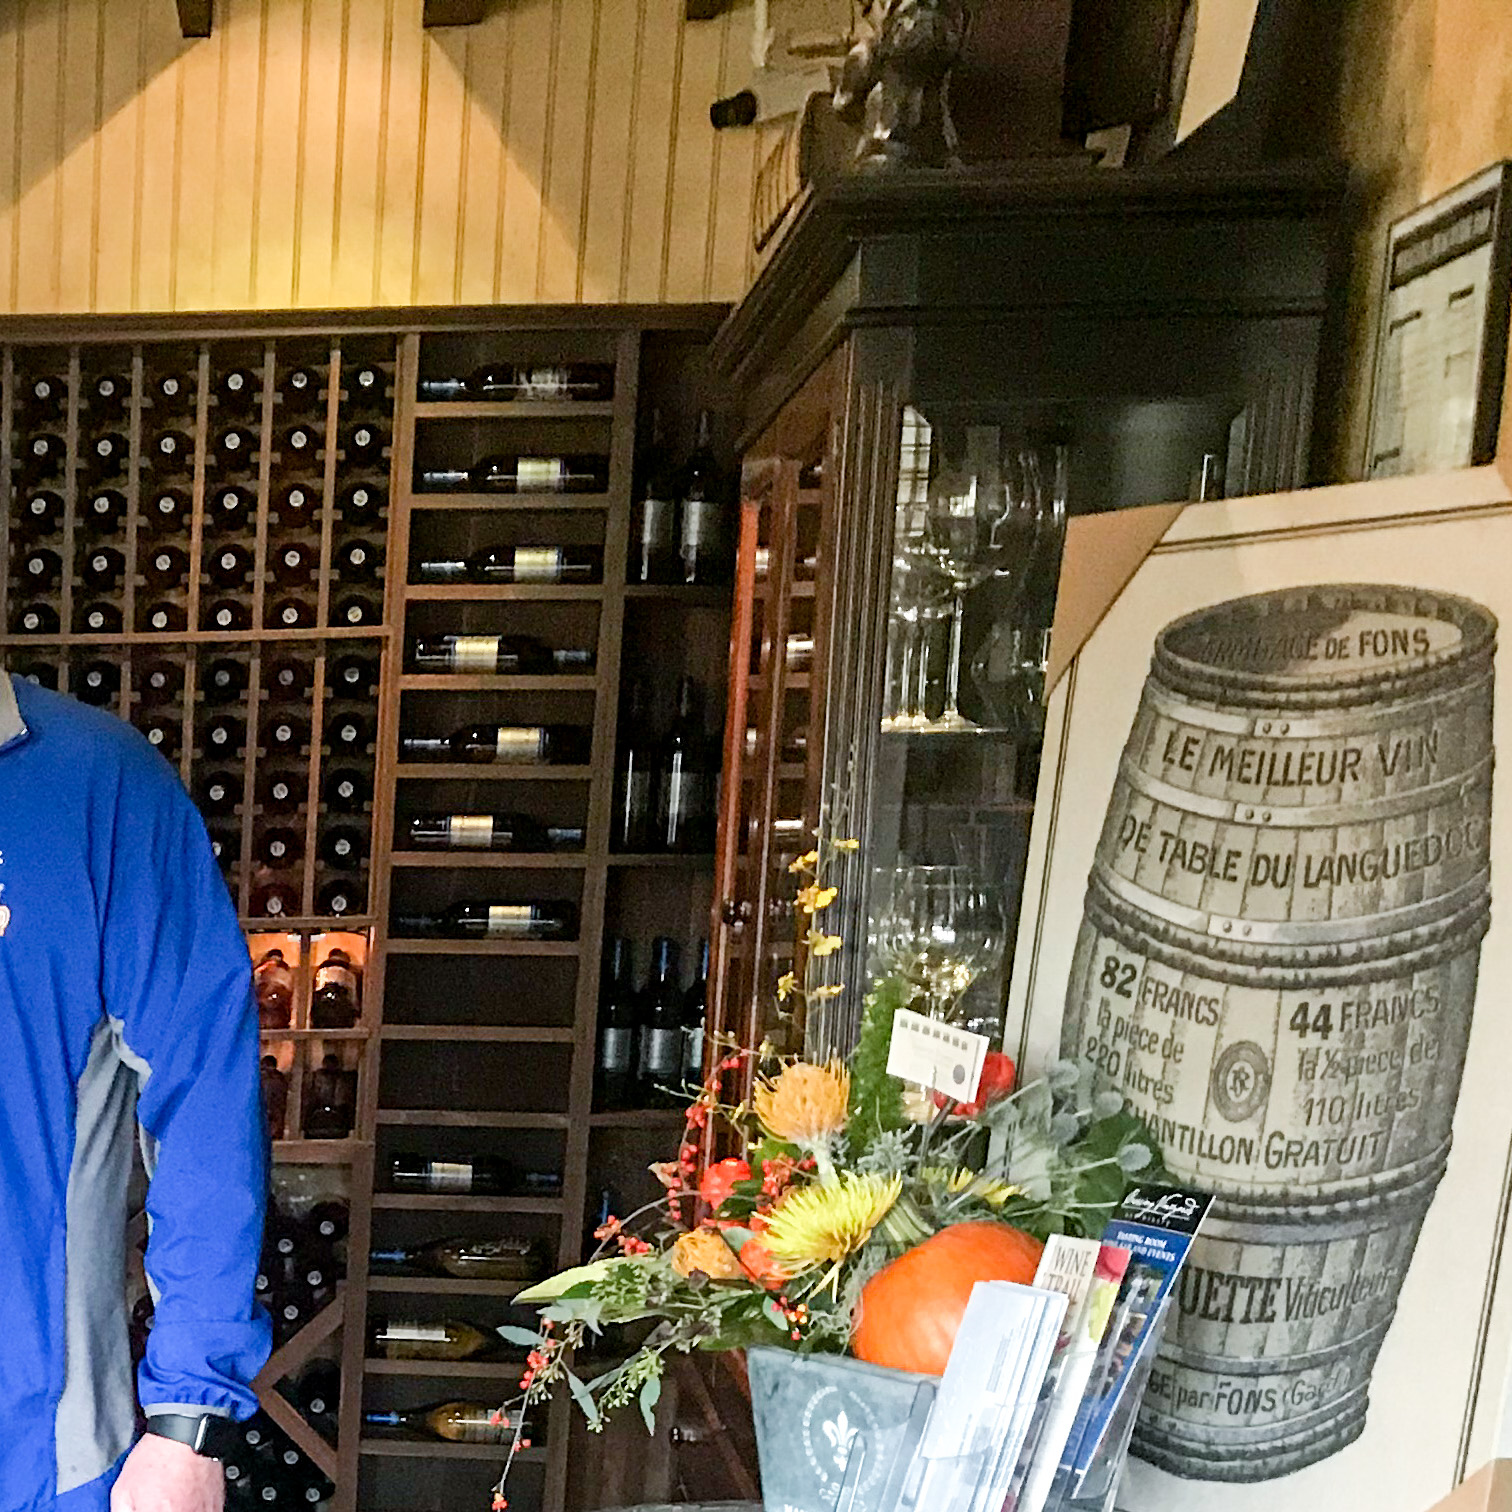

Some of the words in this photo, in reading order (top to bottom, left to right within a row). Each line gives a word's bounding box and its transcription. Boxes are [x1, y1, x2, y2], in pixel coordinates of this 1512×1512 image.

[1325, 636, 1351, 661] DE
[1358, 627, 1431, 657] FONS
[1161, 729, 1201, 773] LE
[1208, 741, 1363, 788] MEILLEUR
[1377, 728, 1440, 779] VIN
[1117, 812, 1151, 856] DE
[1158, 830, 1244, 883] TABLE
[1250, 851, 1293, 890] DU
[1303, 820, 1483, 890] LANGUEDOC
[1099, 955, 1138, 999] 82
[1141, 976, 1220, 1027] FRANCS
[1289, 1001, 1334, 1041] 44
[1339, 986, 1440, 1033] FRANCS
[1096, 996, 1113, 1030] la
[1161, 1032, 1186, 1064] de
[1084, 1035, 1121, 1078] 220
[1123, 1059, 1175, 1105] litres
[1120, 1096, 1255, 1166] CHANTILLON
[1264, 1130, 1387, 1170] GRATUIT
[1303, 1095, 1345, 1127] 110
[1356, 1088, 1420, 1120] litres
[1054, 1246, 1093, 1278] WINE
[1178, 1265, 1283, 1325] UETTE
[1175, 1385, 1210, 1412] par
[1214, 1382, 1279, 1416] FONS
